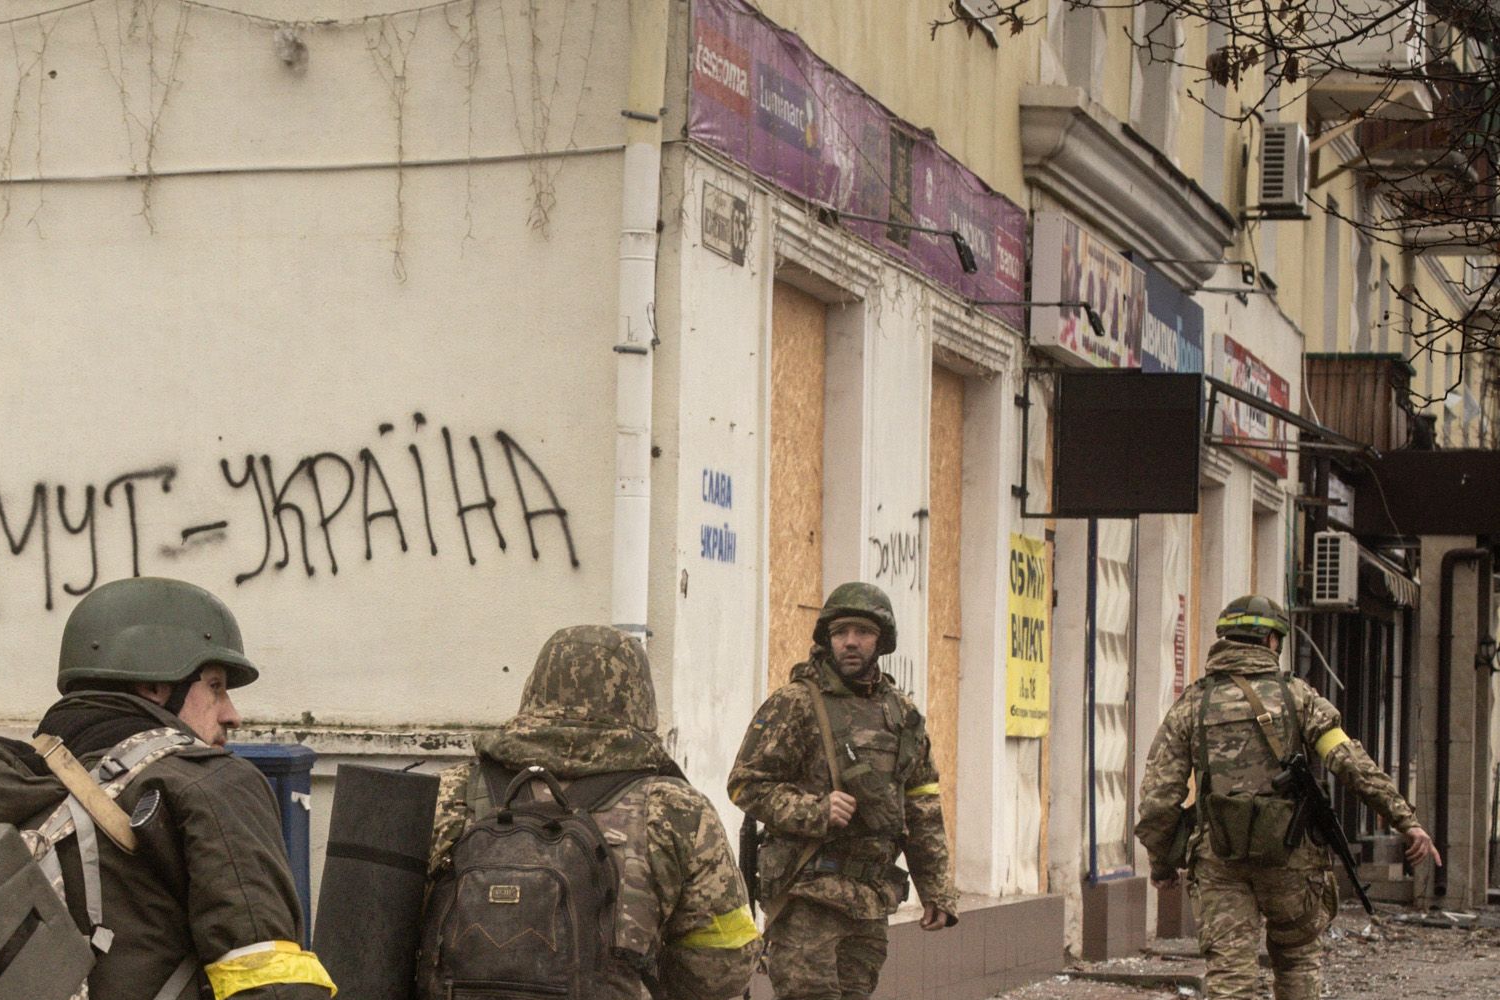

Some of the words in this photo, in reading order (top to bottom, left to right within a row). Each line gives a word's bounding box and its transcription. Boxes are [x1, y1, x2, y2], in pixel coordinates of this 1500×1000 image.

[760, 75, 805, 132] Luminarc
[220, 411, 581, 587] УКРАЇНА
[702, 468, 732, 510] СЛАВА
[701, 522, 737, 564] УКРАЇНІ
